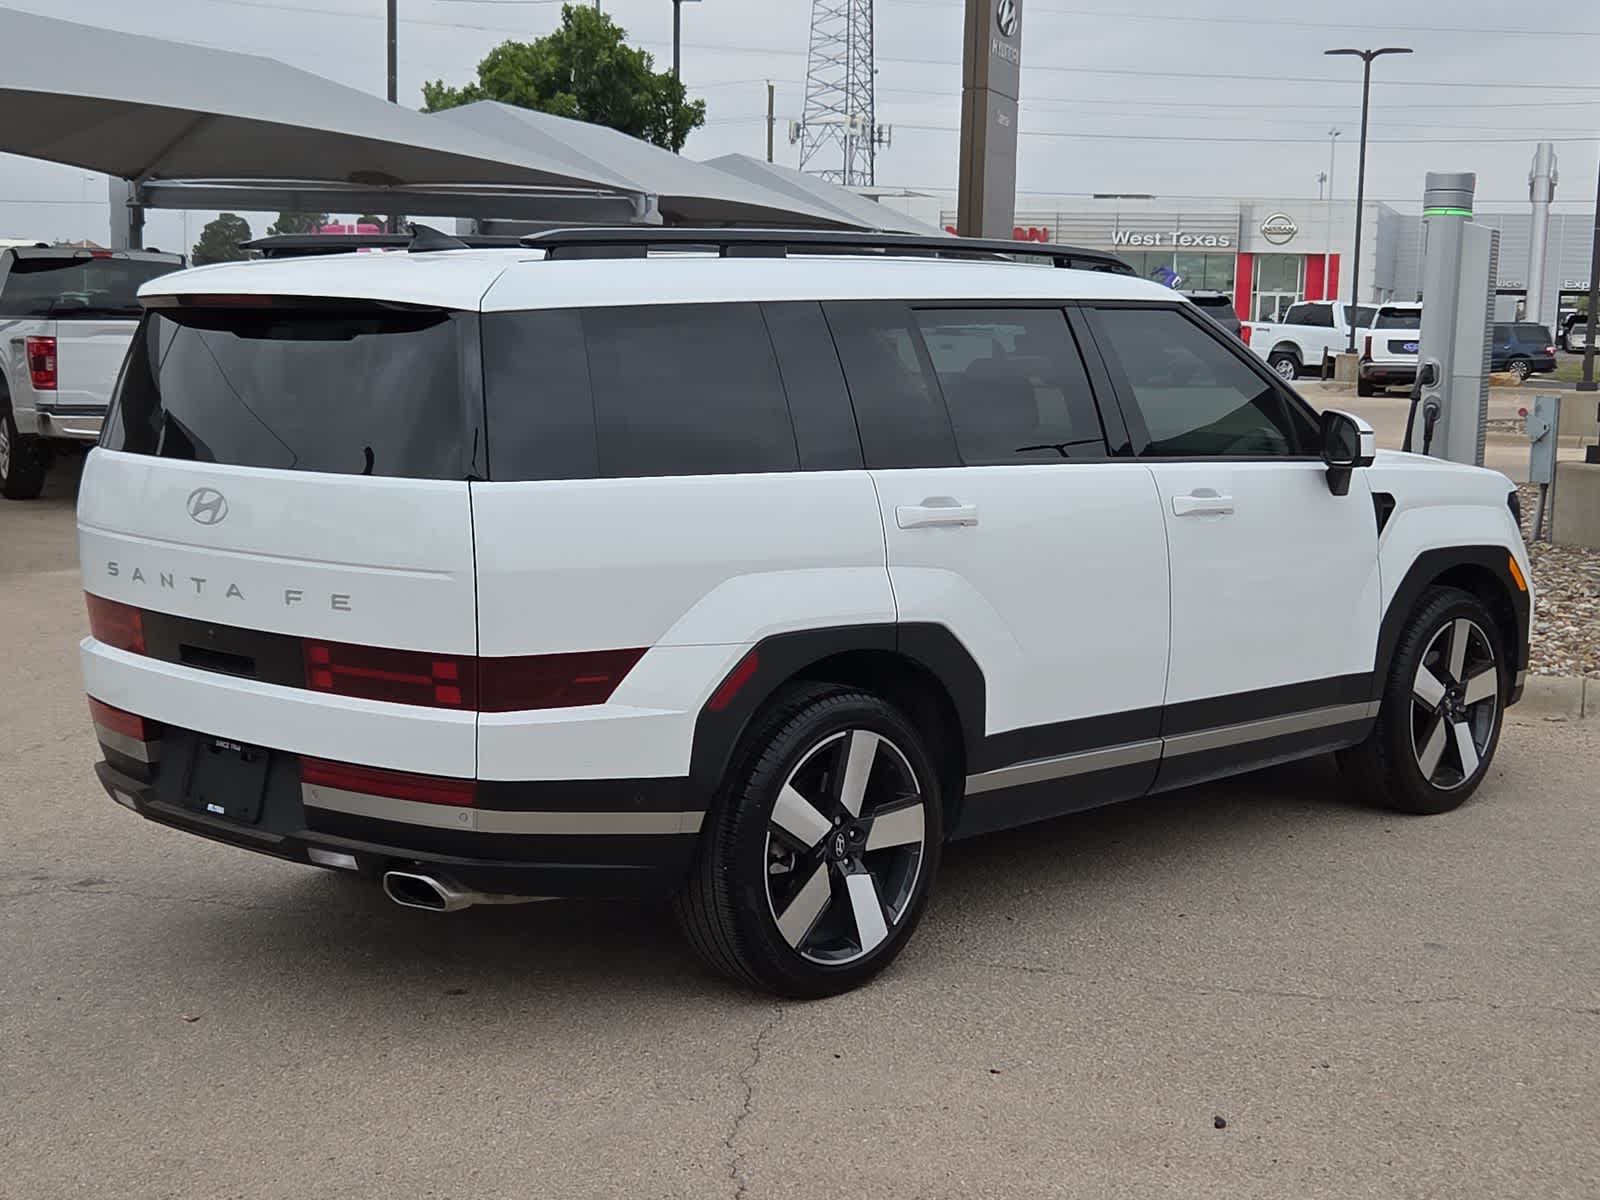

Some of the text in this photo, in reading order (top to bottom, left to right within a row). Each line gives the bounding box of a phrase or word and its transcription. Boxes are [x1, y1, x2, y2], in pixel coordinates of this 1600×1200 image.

[1112, 231, 1230, 247] West Texas
[1564, 279, 1590, 290] Exp
[107, 561, 352, 612] SANTA FE
